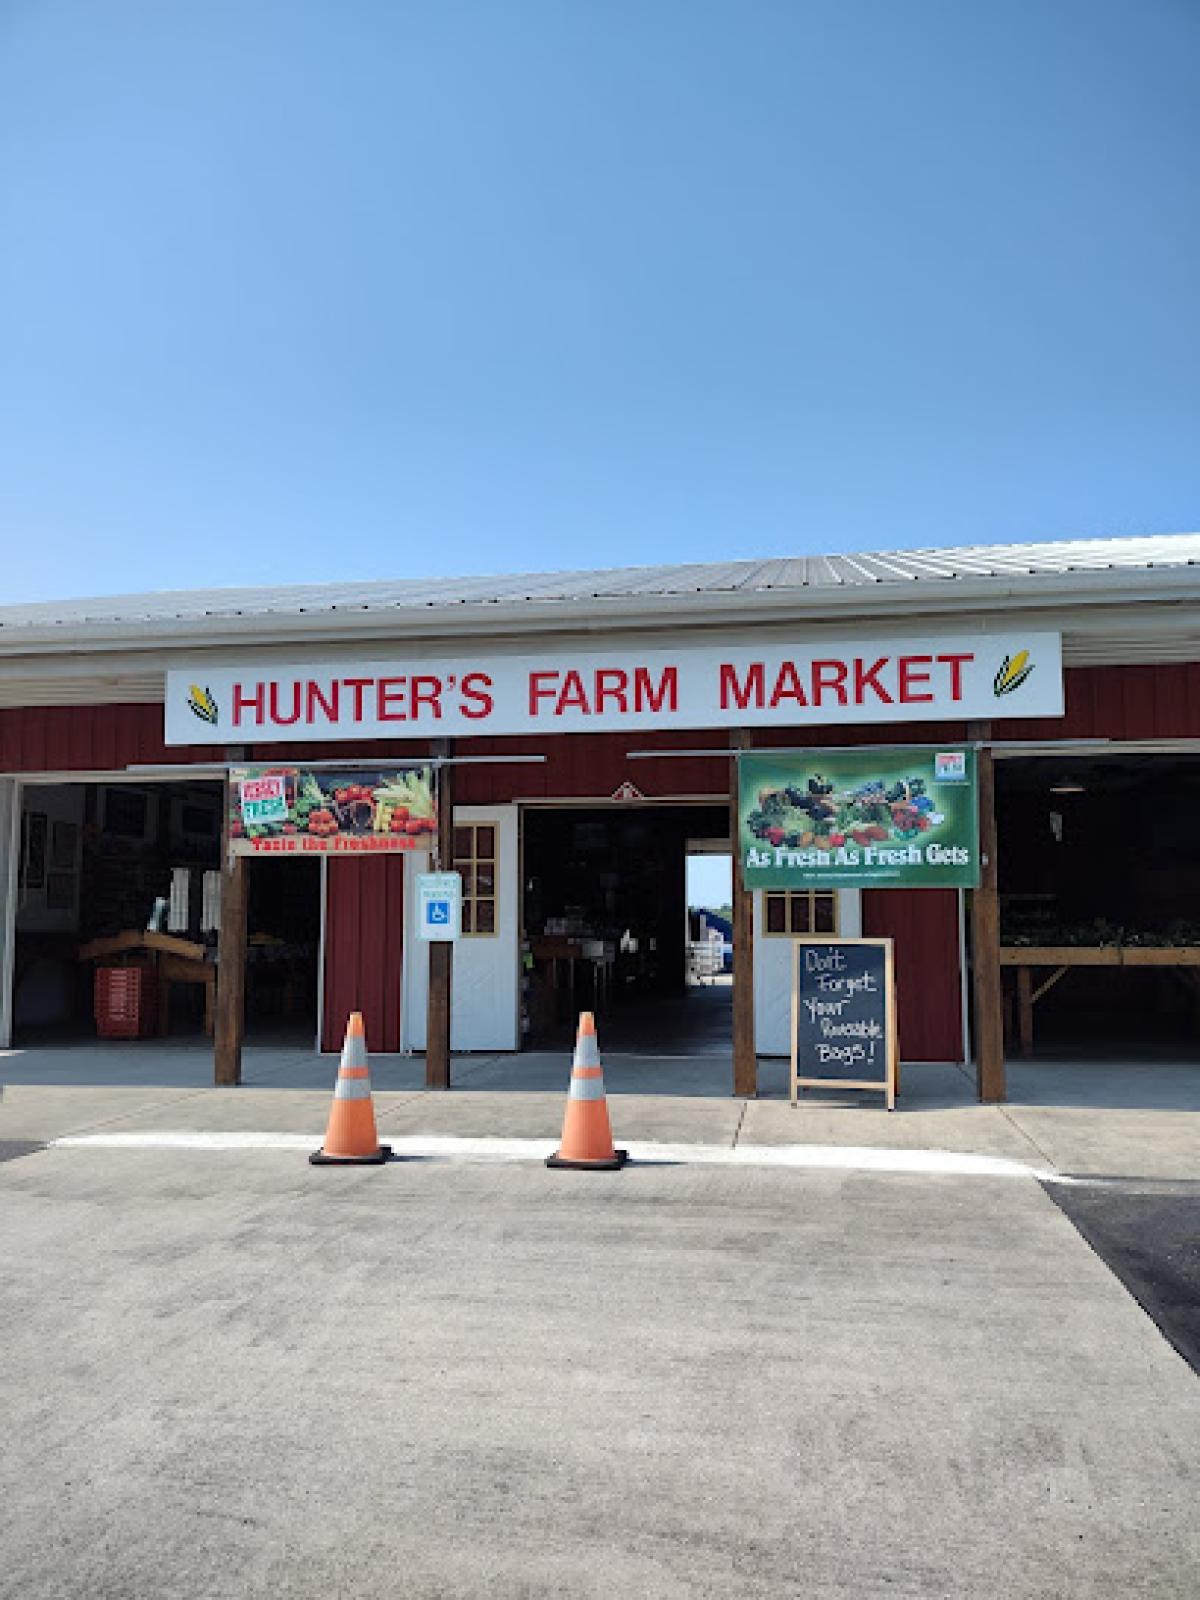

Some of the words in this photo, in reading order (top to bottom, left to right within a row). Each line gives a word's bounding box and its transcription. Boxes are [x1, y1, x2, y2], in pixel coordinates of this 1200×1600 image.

[232, 672, 493, 726] HUNTER'S
[528, 667, 678, 717] FARM
[719, 654, 975, 709] MARKET
[302, 837, 328, 851] the
[746, 847, 771, 868] As
[775, 846, 830, 867] Fresh
[834, 846, 860, 866] As
[864, 843, 922, 865] Fresh
[926, 843, 969, 865] Gets
[815, 970, 877, 998] Forget
